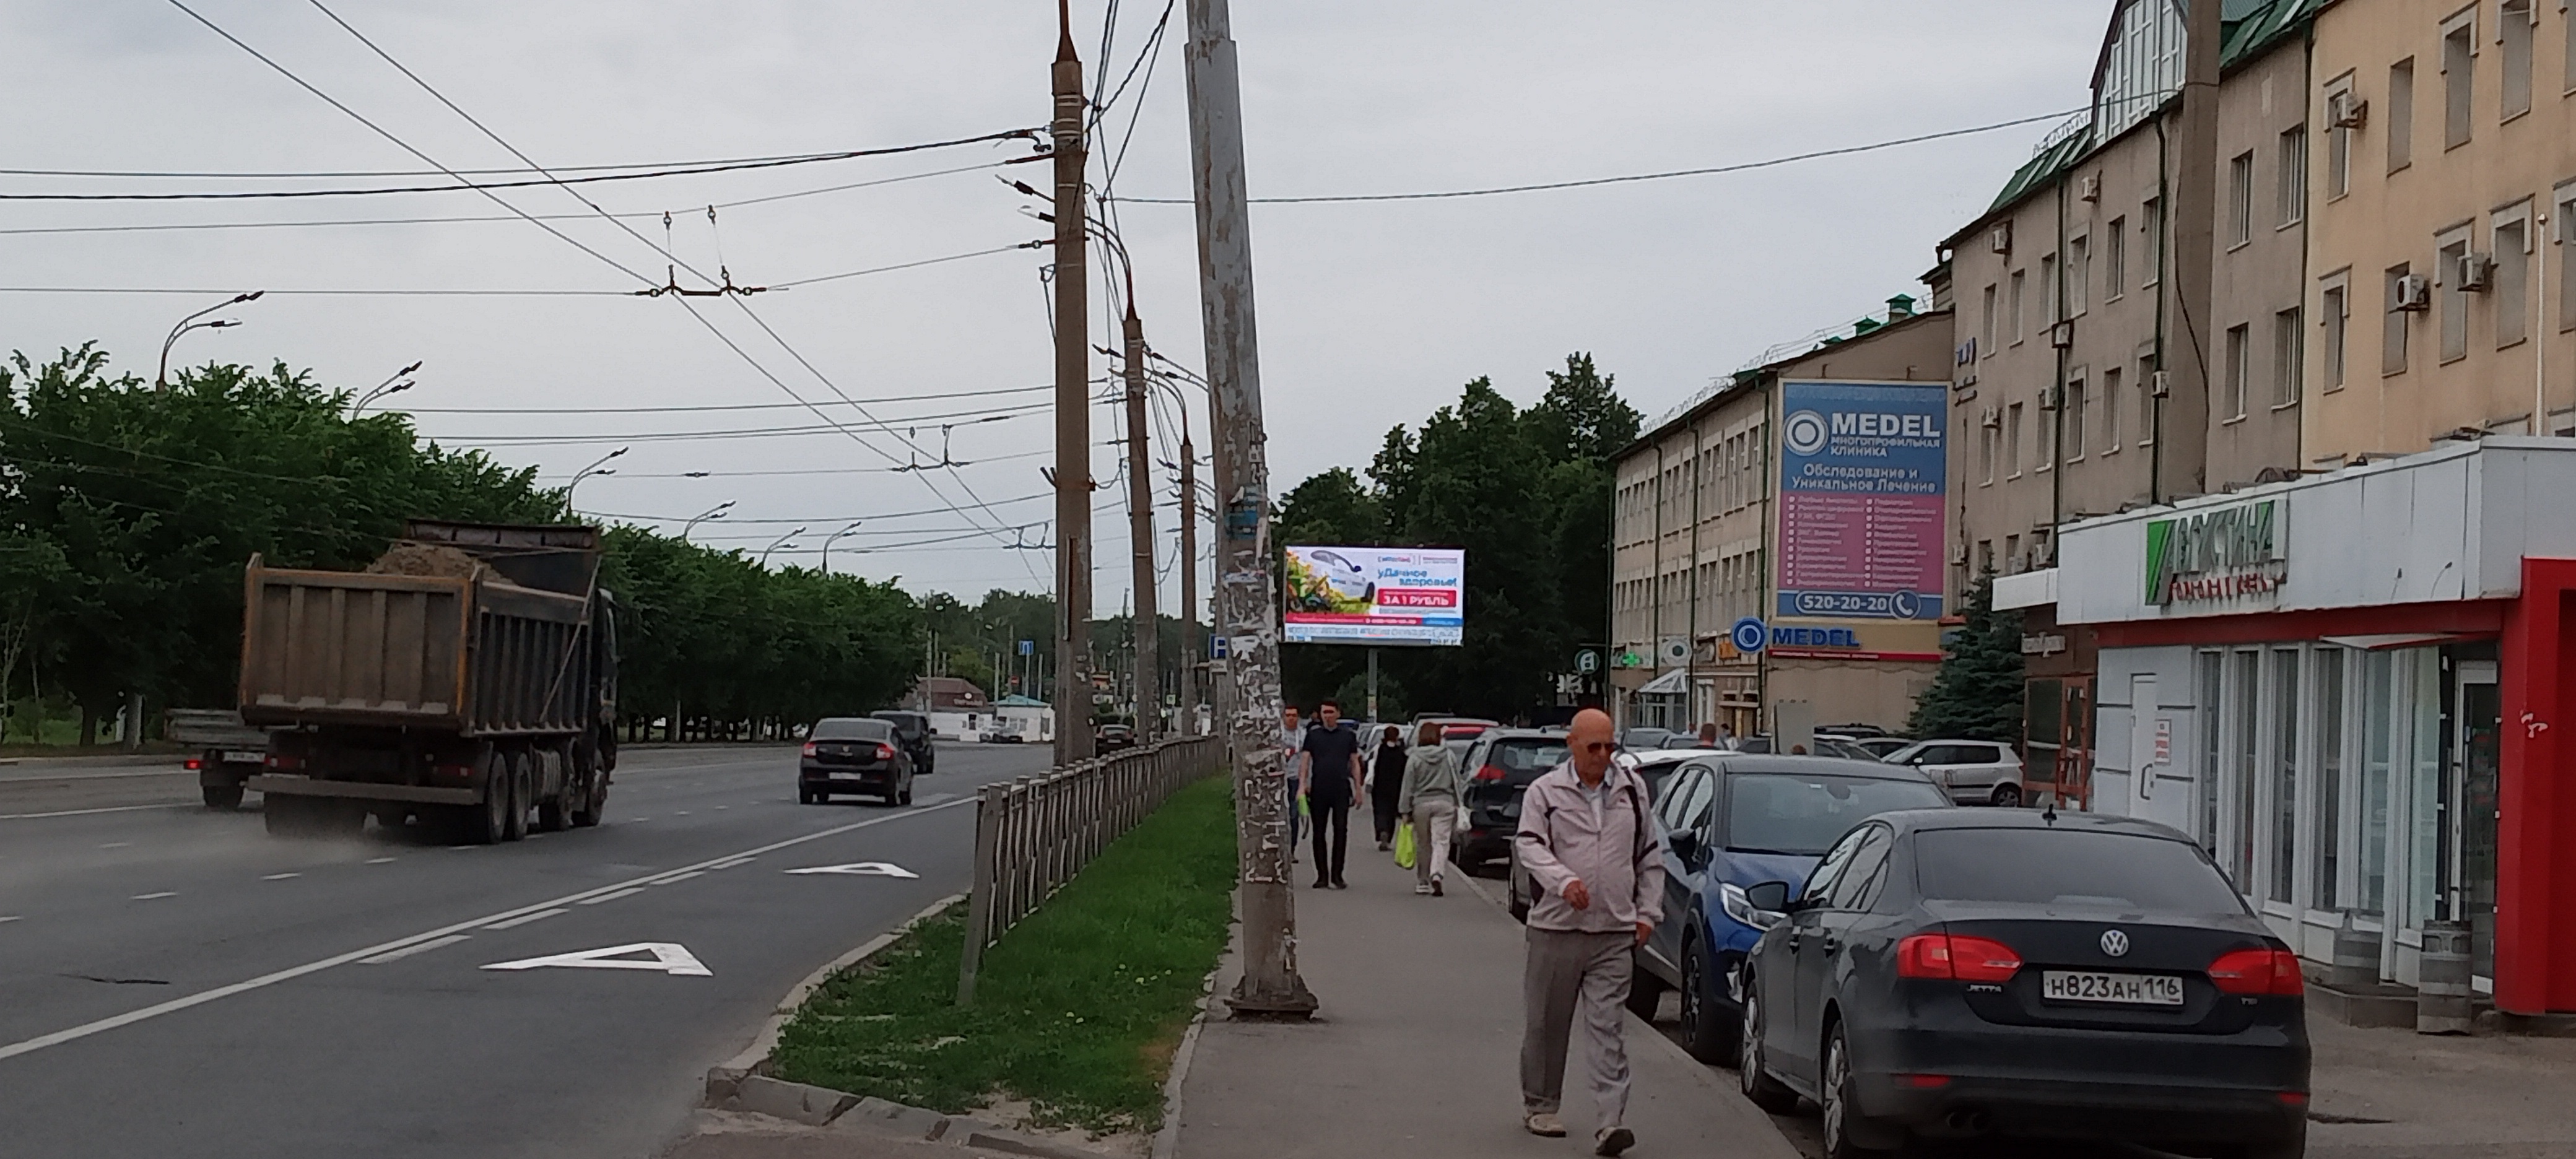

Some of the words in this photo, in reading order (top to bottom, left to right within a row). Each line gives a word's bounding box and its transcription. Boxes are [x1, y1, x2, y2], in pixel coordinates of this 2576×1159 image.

[1832, 412, 1941, 437] MEDEL
[1830, 436, 1940, 448] МНОГОПРОФИЛЬНАЯ
[1830, 446, 1887, 457] КЛИНИКА
[1803, 463, 1905, 479] Обследование
[1909, 469, 1918, 479] и
[1791, 476, 1874, 491] Уникальное
[1877, 479, 1936, 493] Лечение
[1383, 595, 1400, 605] ЗА
[1409, 596, 1449, 606] РУБЛЬ
[1803, 596, 1887, 610] 520-20-20
[1772, 628, 1860, 647] MEDEL
[2052, 975, 2140, 999] Н823АН
[2144, 978, 2180, 996] 116
